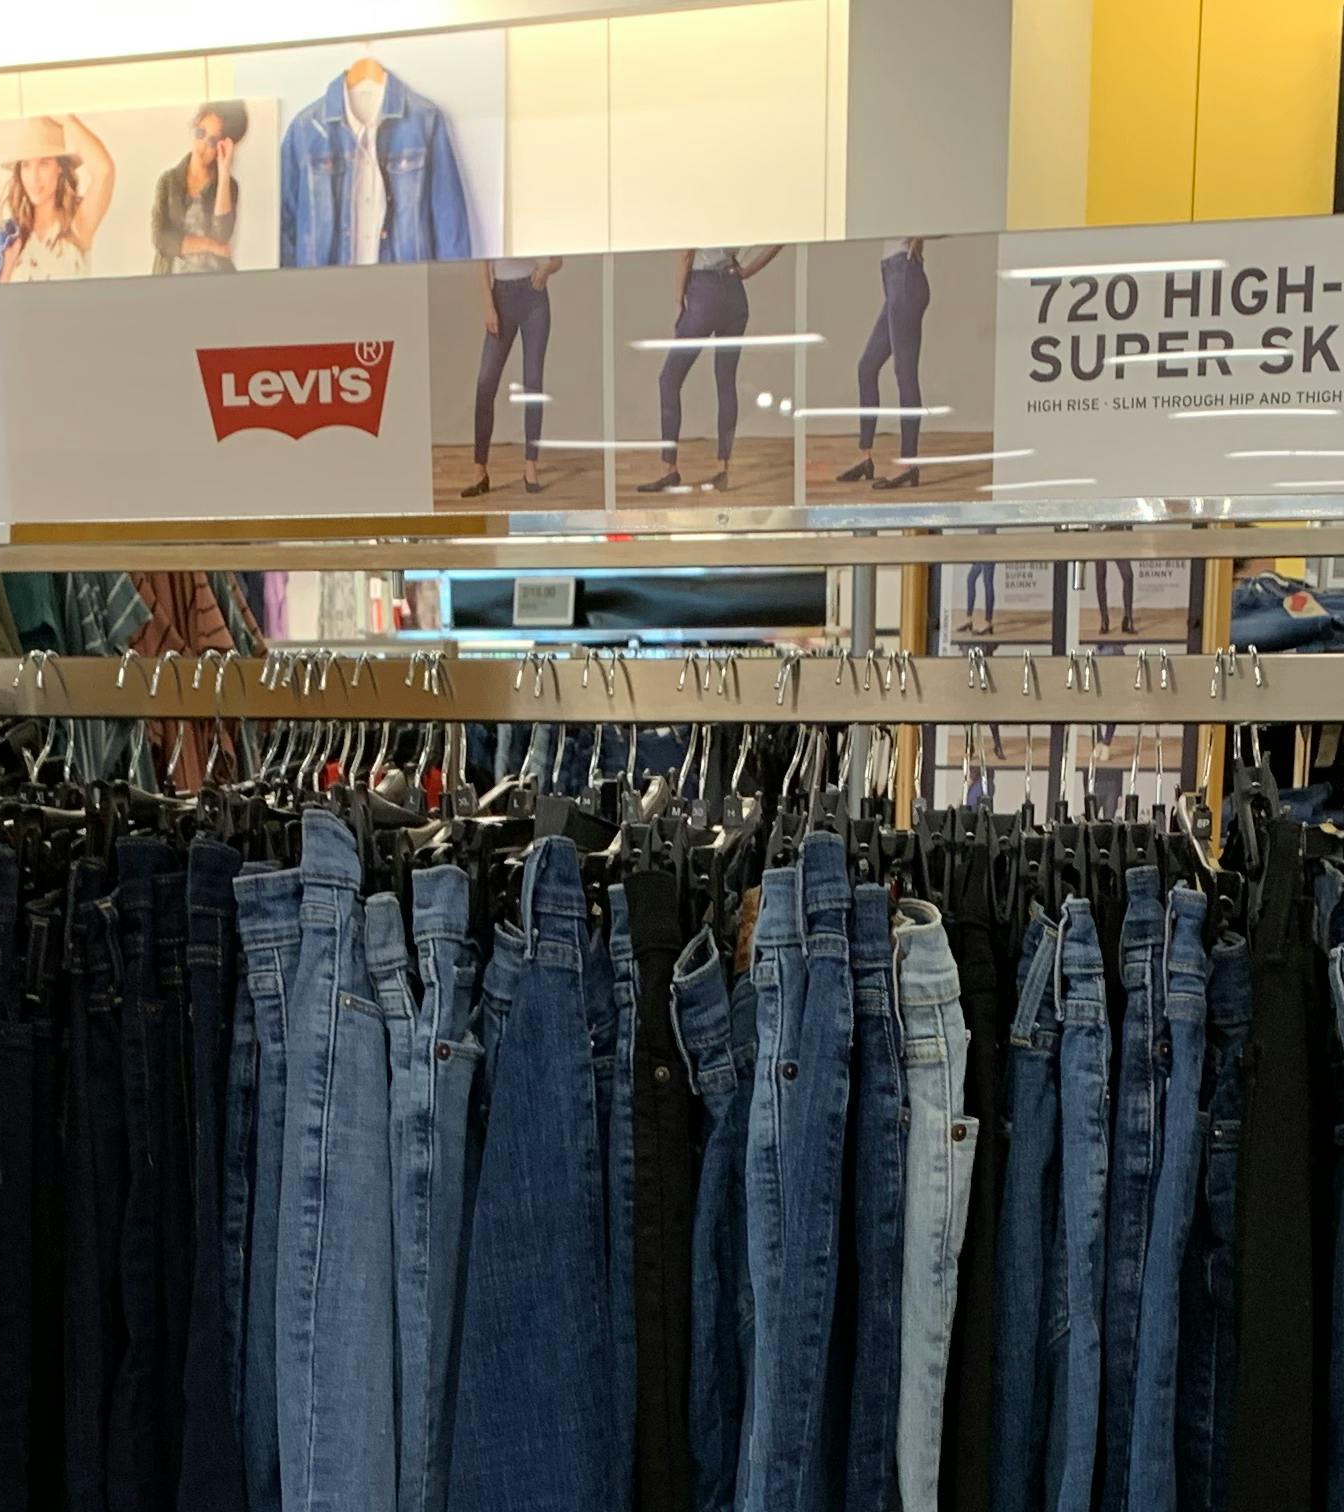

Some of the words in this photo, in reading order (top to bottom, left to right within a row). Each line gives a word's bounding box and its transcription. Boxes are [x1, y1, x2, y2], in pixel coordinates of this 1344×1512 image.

[1030, 274, 1139, 324] 720
[1029, 329, 1233, 383] SUPER
[1027, 399, 1062, 412] HIGH
[1067, 398, 1100, 411] RISE
[1112, 396, 1147, 410] SLIM
[1152, 394, 1225, 409] THROUGH
[1229, 393, 1255, 406] HIP
[1259, 392, 1291, 405] AND
[1296, 390, 1343, 404] THIGH
